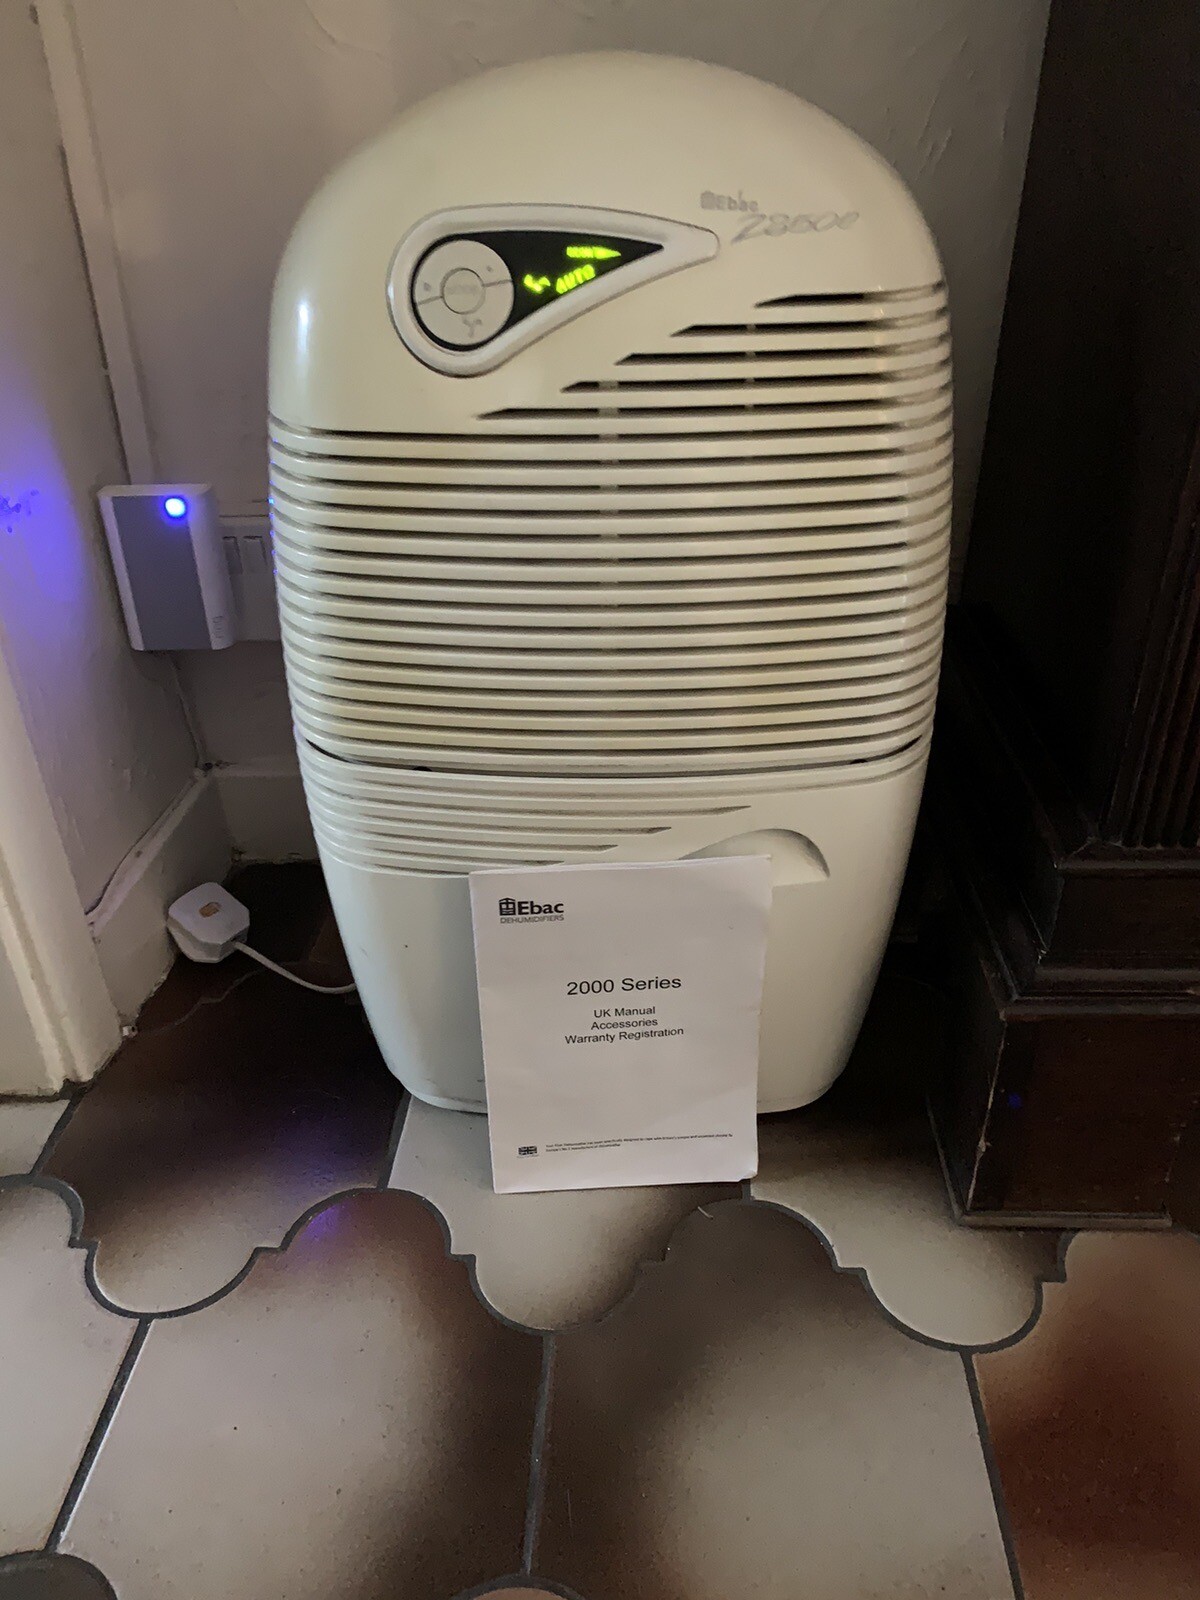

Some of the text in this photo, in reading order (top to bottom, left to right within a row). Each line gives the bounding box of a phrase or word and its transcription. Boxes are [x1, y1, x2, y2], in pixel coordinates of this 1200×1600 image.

[517, 901, 564, 915] Ebac
[500, 914, 564, 924] DEHUMIDIFIERS
[567, 976, 682, 995] 2000 Series
[593, 1006, 656, 1018] UK Manual
[591, 1018, 658, 1030] Accessories
[565, 1028, 684, 1044] Warranty Registration
